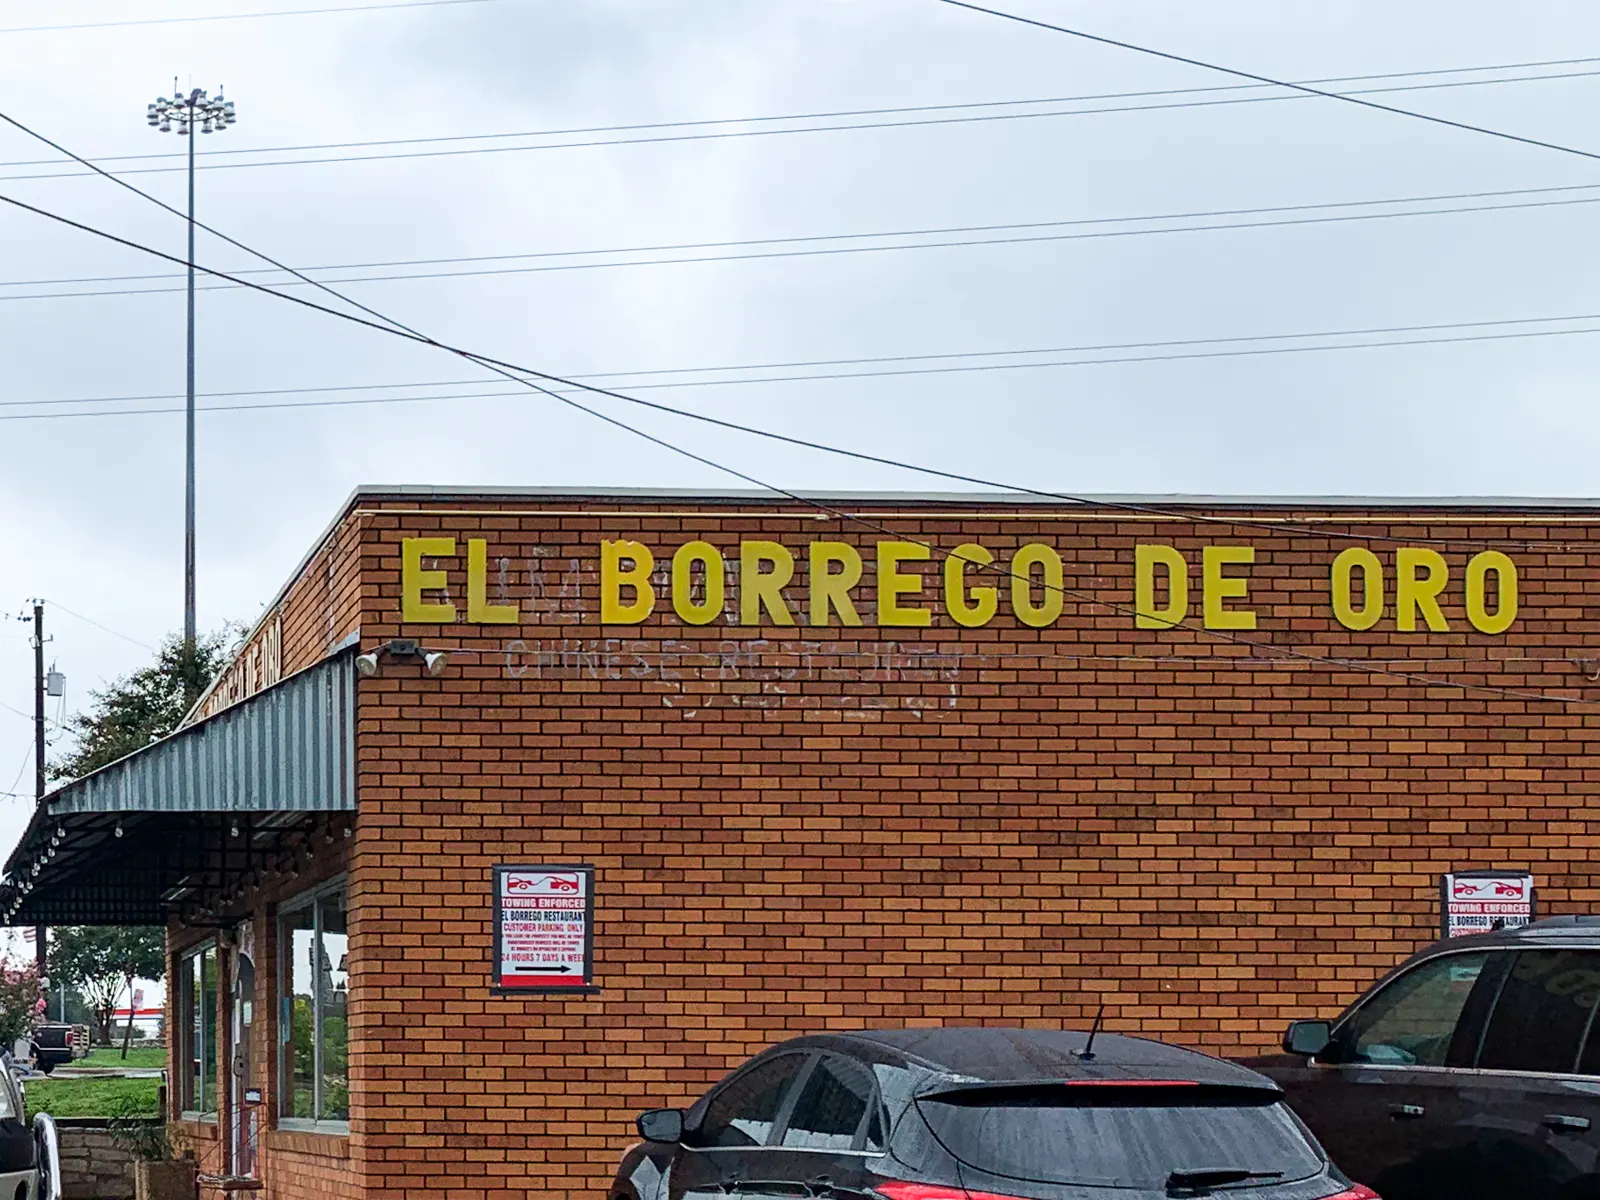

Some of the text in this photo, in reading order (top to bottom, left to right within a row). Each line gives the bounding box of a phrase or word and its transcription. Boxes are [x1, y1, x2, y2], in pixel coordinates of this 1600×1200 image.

[401, 537, 519, 625] EL
[600, 538, 1064, 629] BORREGO
[1134, 544, 1258, 630] DE
[1330, 546, 1518, 635] ORO
[502, 898, 586, 908] TOWING ENFORCED
[1448, 904, 1531, 913] TOWING ENFORCED
[511, 911, 542, 921] BORREGO
[504, 923, 536, 932] CUSTOMER
[538, 923, 564, 932] PARKING
[512, 953, 534, 962] HOURS
